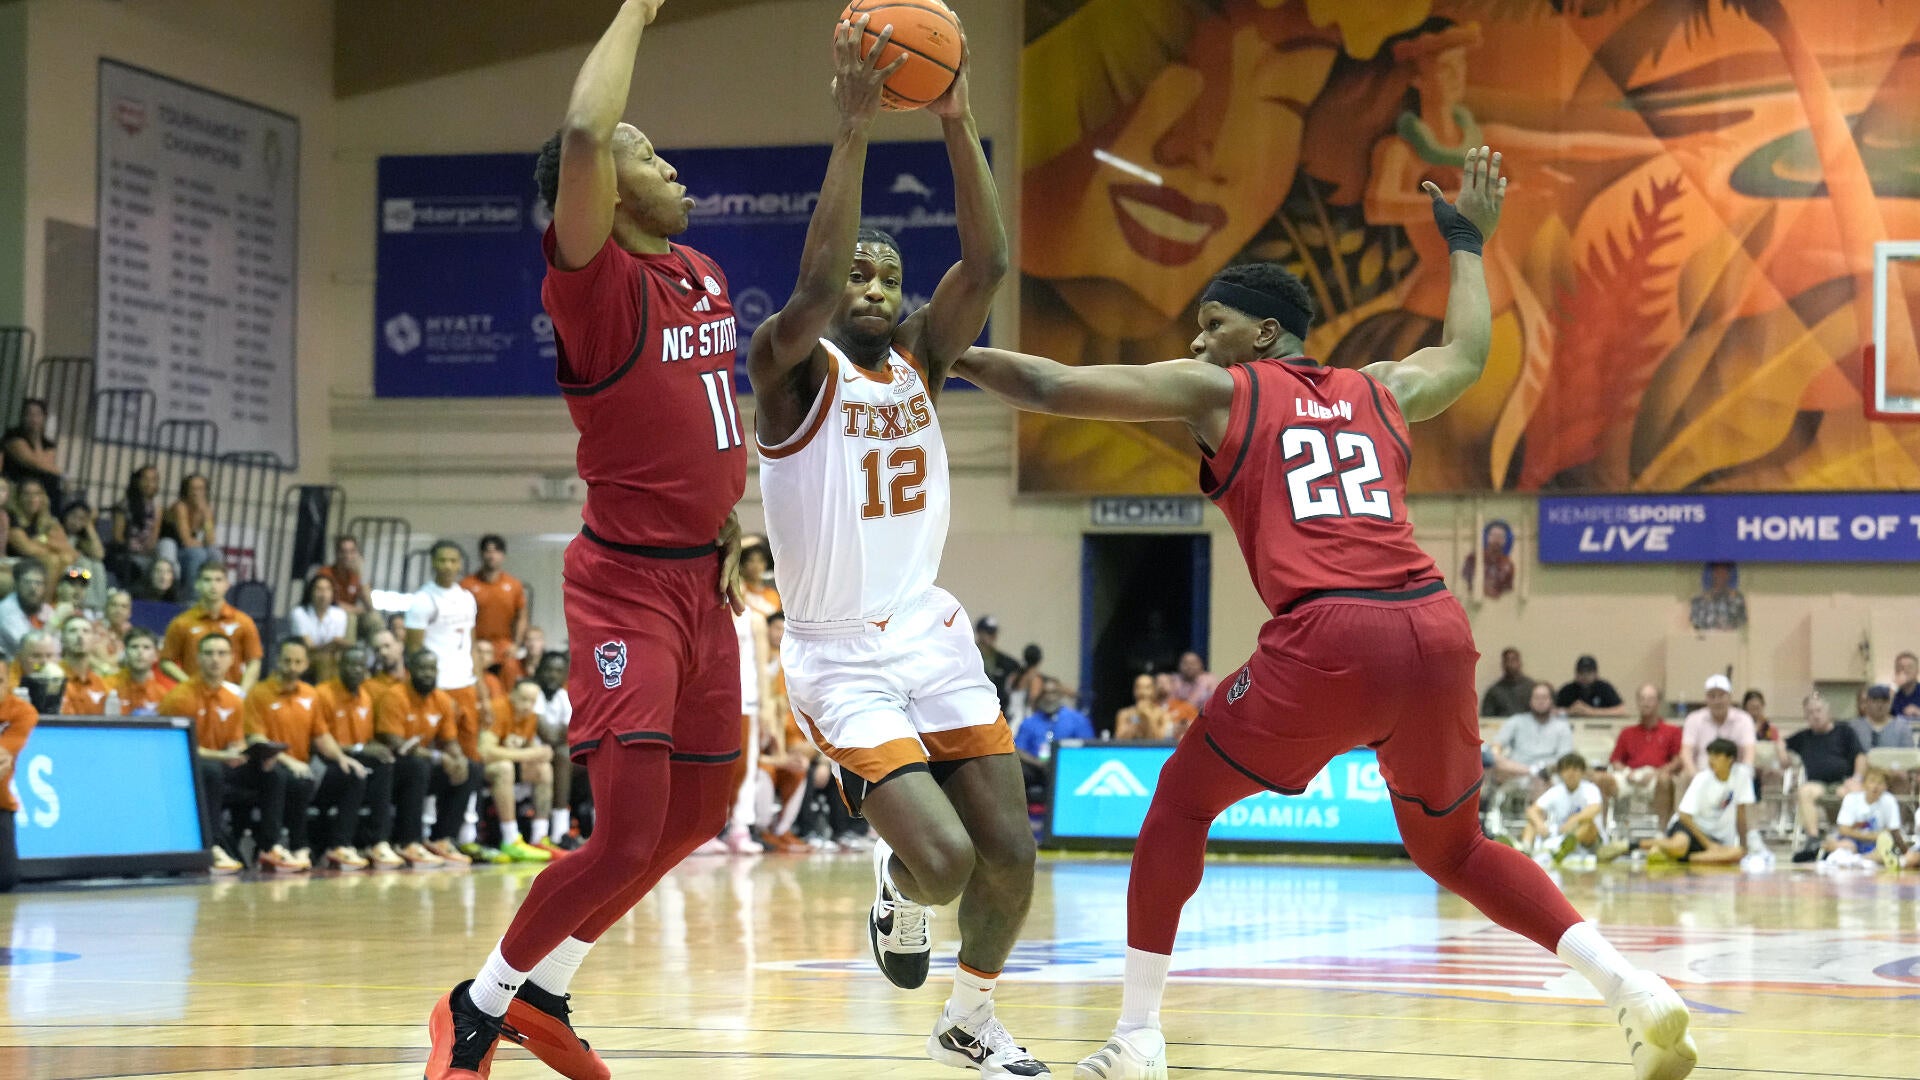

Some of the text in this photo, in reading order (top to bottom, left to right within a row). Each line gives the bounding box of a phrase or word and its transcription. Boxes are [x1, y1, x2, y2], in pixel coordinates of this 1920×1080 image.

[425, 314, 495, 332] HYATT
[662, 324, 695, 362] NC
[701, 369, 742, 450] 11
[841, 393, 932, 441] TEXAS
[1295, 397, 1352, 421] LUBIN
[861, 446, 927, 520] 12
[1280, 425, 1394, 524] 22
[1100, 498, 1197, 522] HOME
[1548, 504, 1706, 524] KEMPERSPORTS
[1578, 525, 1675, 552] LIVE
[1736, 515, 1840, 541] HOME
[1850, 515, 1900, 541] OF
